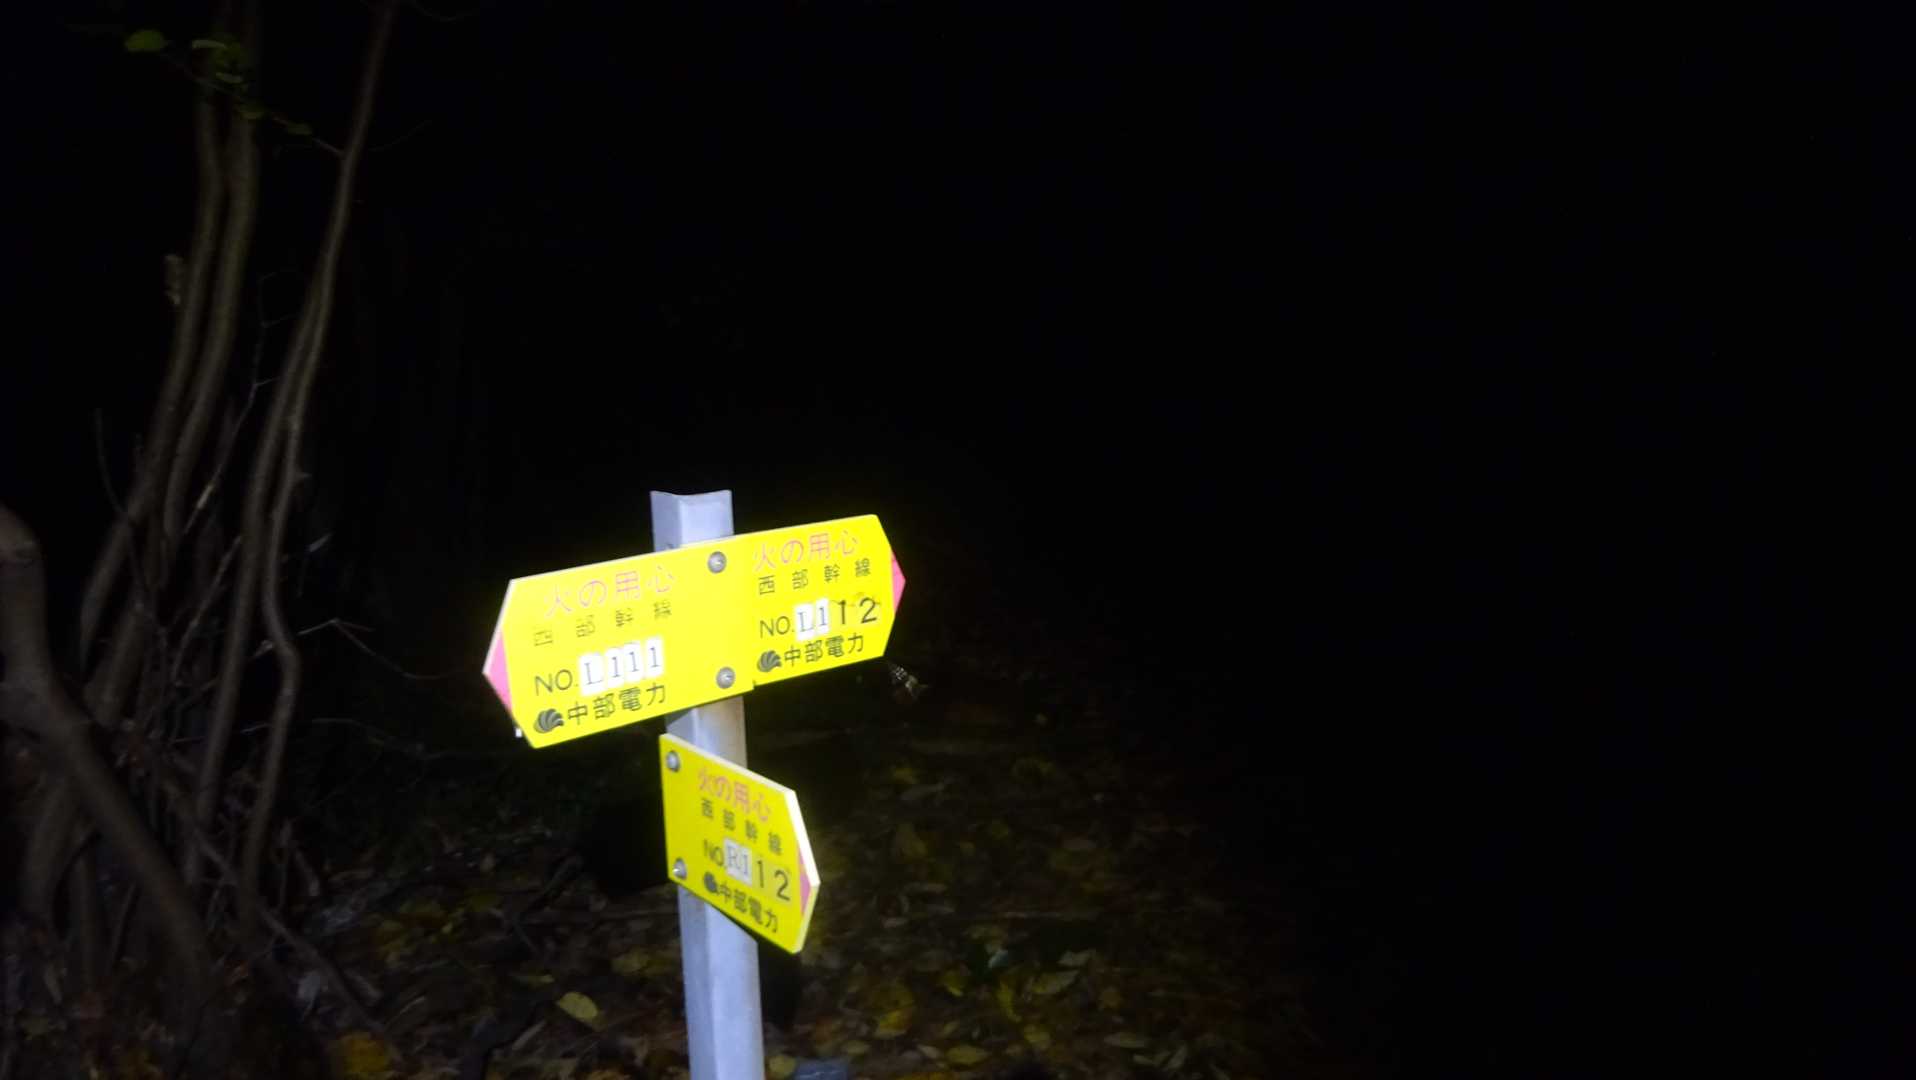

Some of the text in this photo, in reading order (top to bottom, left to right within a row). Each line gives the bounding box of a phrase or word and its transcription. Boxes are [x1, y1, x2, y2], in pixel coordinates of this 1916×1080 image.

[753, 530, 860, 571] 火の用心
[544, 565, 676, 618] 火の用心
[758, 558, 871, 595] 西部幹線
[784, 633, 864, 666] 中部電力
[567, 683, 666, 725] 中部電力
[698, 767, 772, 822] 火の用心
[718, 881, 779, 933] 中部電力
